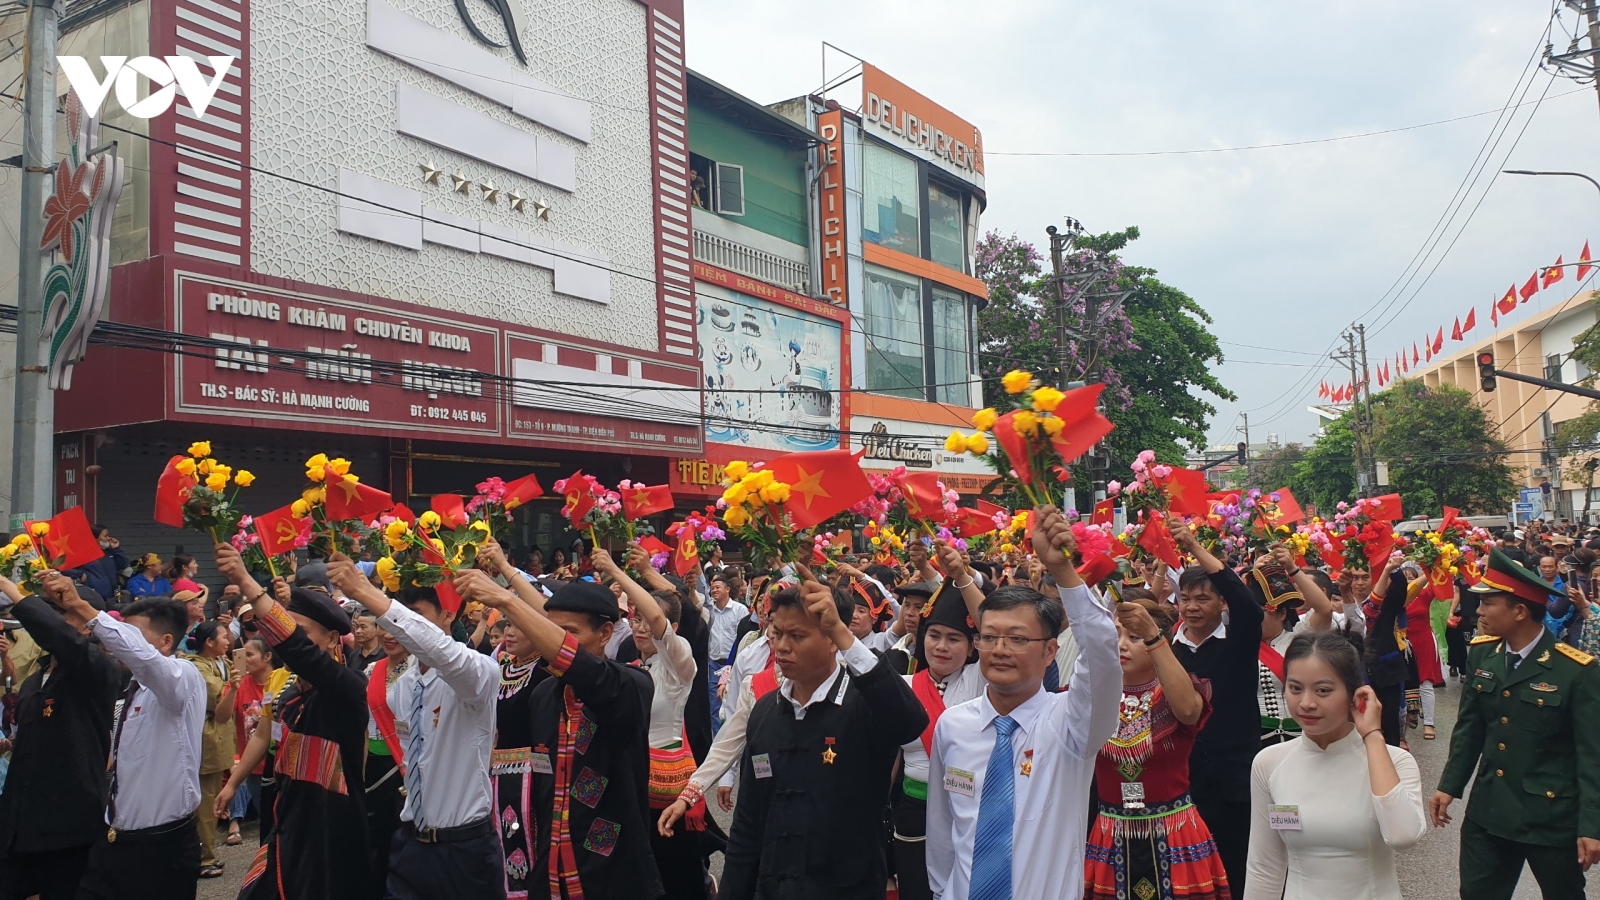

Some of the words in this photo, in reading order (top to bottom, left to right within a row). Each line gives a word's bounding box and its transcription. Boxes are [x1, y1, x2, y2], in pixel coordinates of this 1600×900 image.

[867, 91, 974, 173] DELICHICKEN
[737, 279, 776, 298] BÁNH
[207, 291, 280, 320] PHÒNG
[288, 308, 346, 331] KHÁM
[354, 318, 422, 344] CHUYÊN
[428, 331, 470, 352] KHOA
[200, 383, 226, 398] TH.S
[235, 385, 258, 402] BÁC
[282, 390, 298, 406] HÀ
[300, 394, 332, 410] MẠNH
[335, 395, 370, 412] CƯỜNG
[428, 406, 450, 420] 0912
[452, 409, 468, 421] 445
[470, 411, 486, 423] 045
[65, 469, 76, 484] TAI
[679, 458, 726, 490] TIỆM
